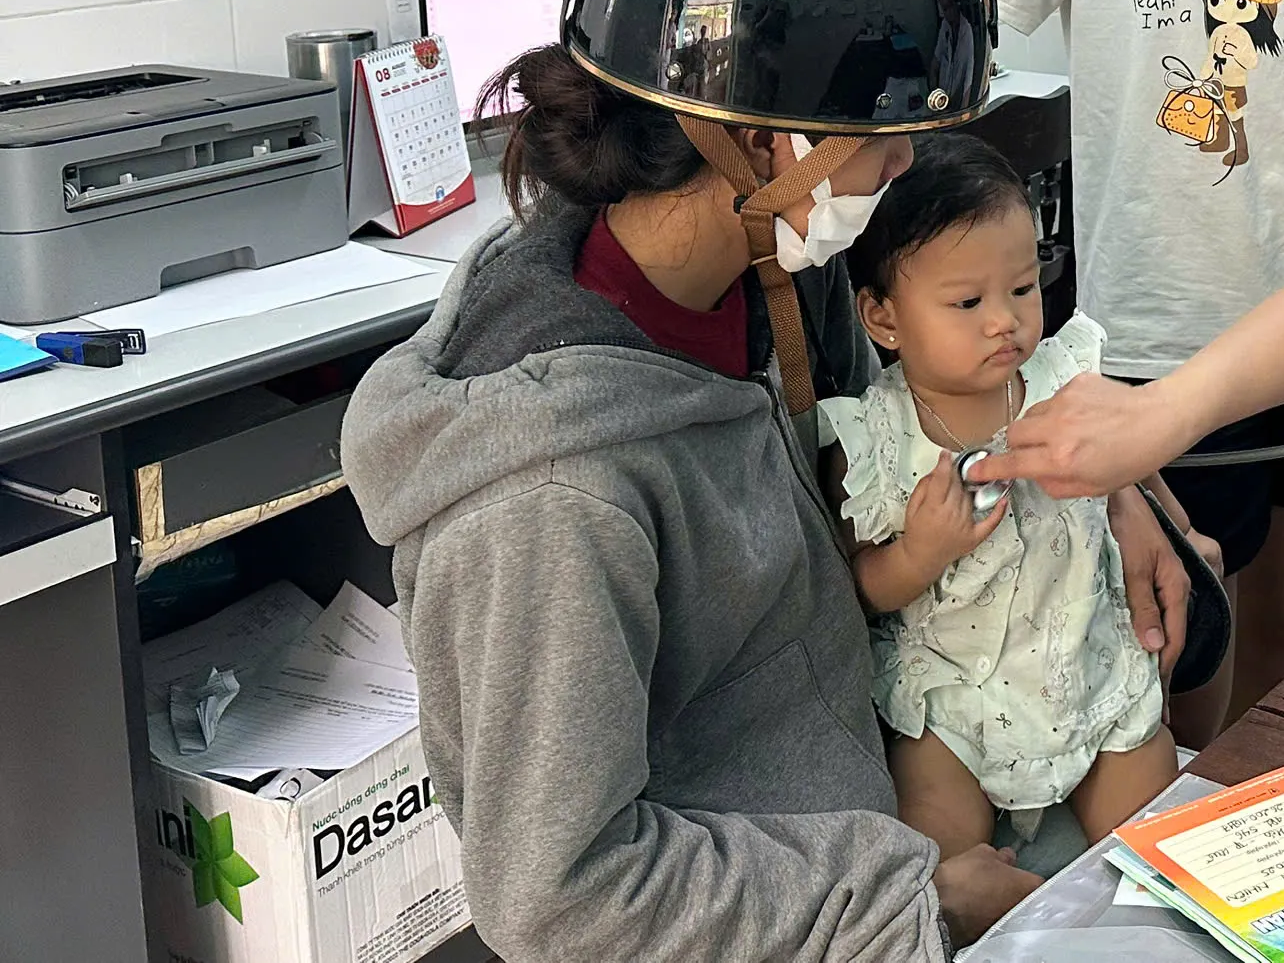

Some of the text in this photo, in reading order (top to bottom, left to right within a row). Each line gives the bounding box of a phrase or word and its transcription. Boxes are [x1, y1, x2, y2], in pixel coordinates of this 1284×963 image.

[375, 68, 391, 83] 08
[312, 810, 337, 833] Nước
[390, 764, 410, 781] chai
[318, 875, 343, 896] Thanh
[363, 847, 386, 866] trong
